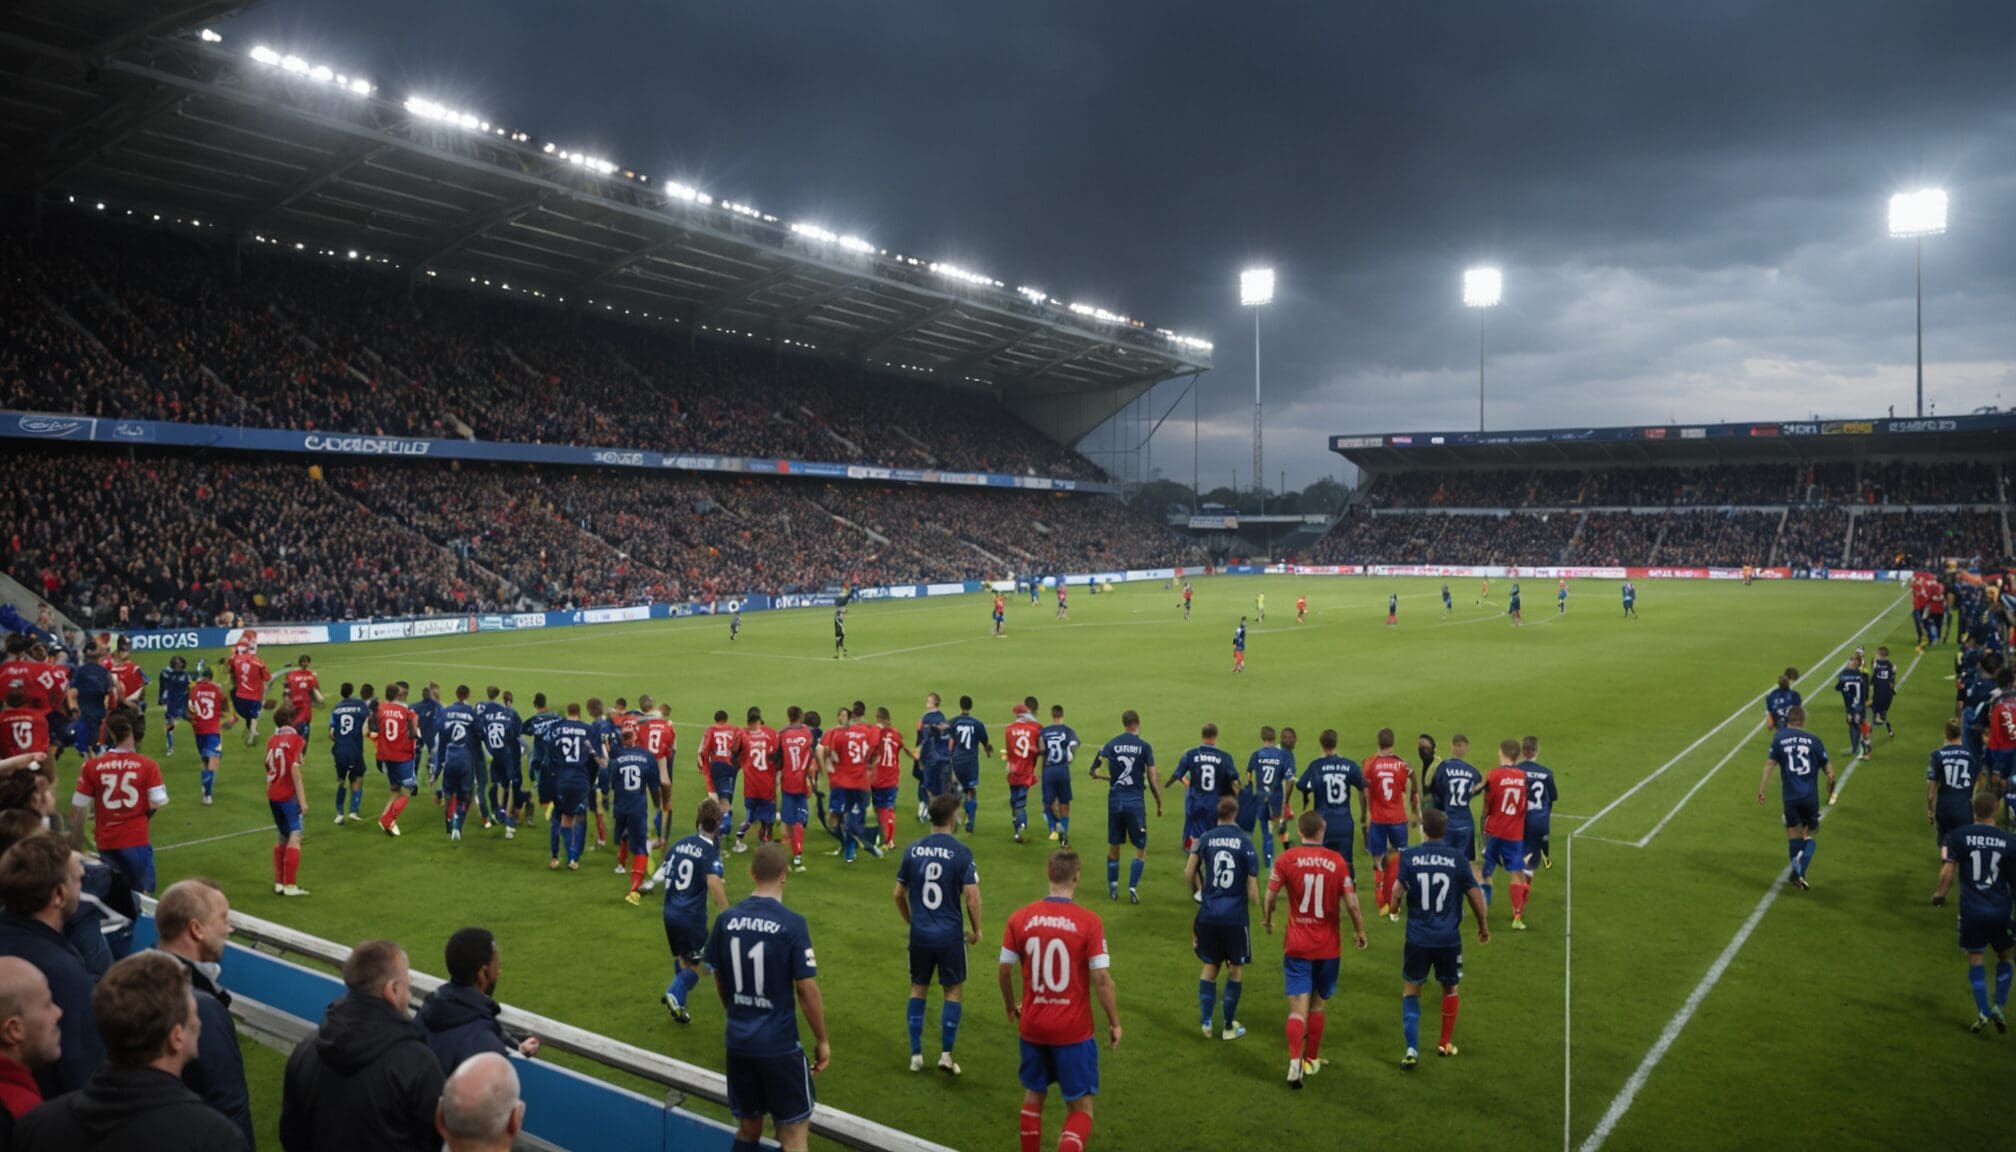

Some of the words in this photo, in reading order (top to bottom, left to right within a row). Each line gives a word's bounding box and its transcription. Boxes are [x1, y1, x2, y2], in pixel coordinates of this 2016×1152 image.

[101, 771, 139, 809] 25
[1416, 872, 1451, 913] 17
[730, 936, 765, 996] 11
[1025, 935, 1071, 992] 10
